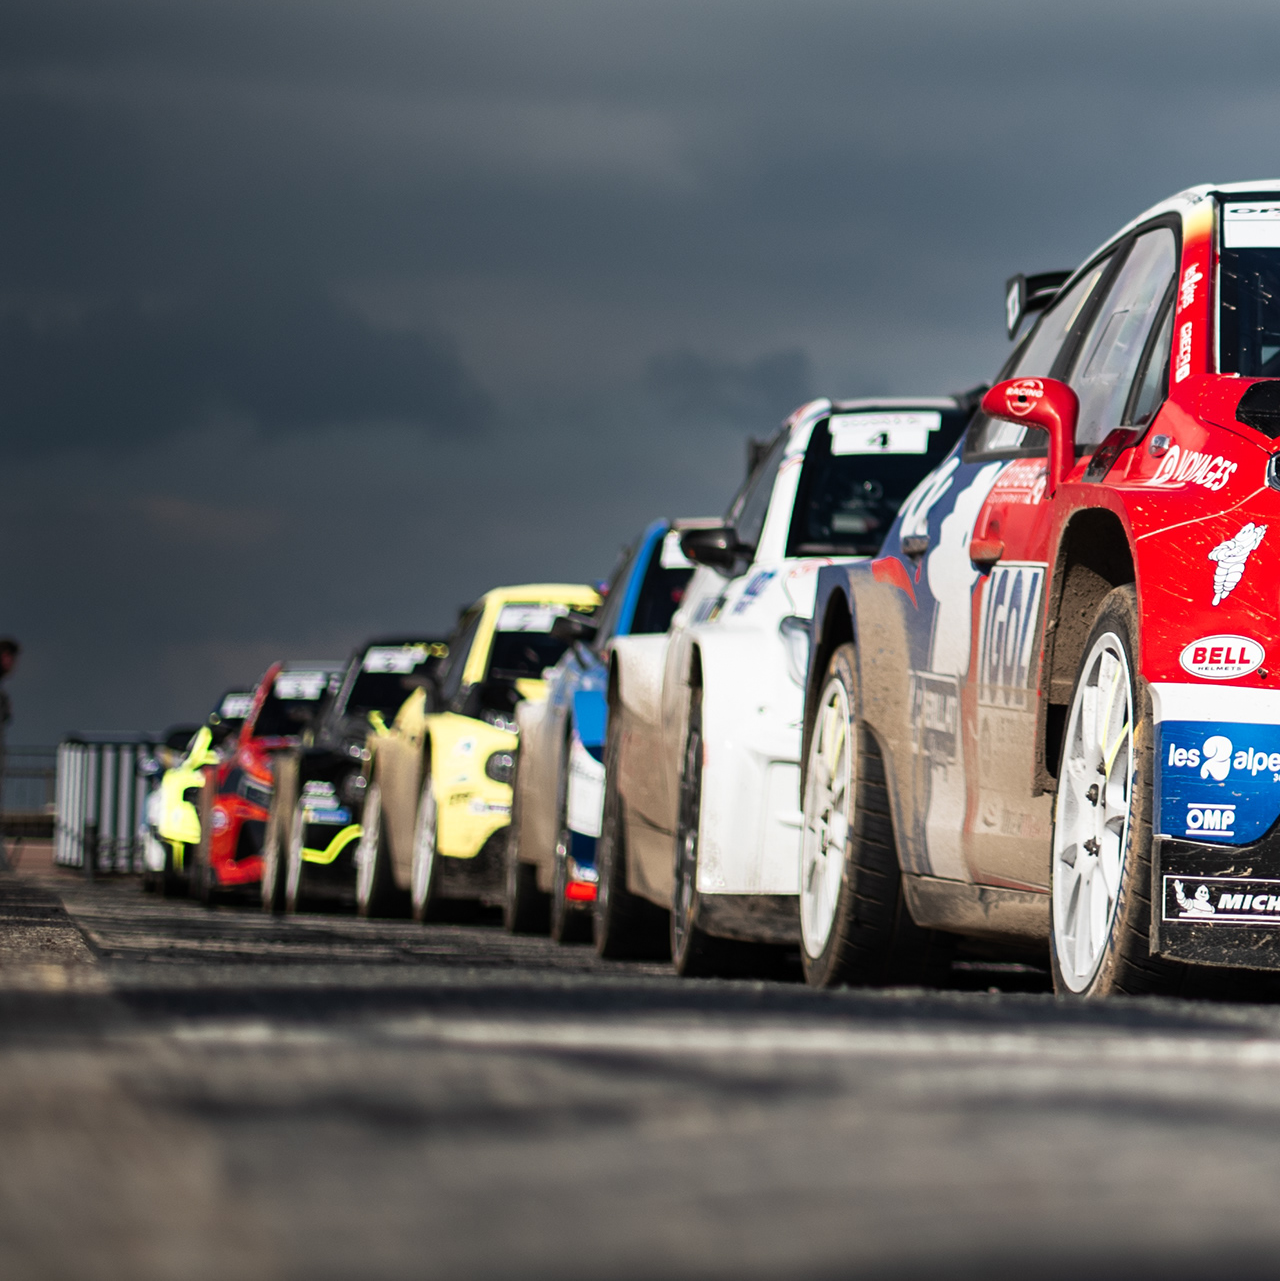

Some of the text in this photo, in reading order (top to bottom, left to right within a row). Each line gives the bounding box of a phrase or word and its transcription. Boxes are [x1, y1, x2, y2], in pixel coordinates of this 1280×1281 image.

[1006, 387, 1043, 398] RACING
[1173, 449, 1238, 491] VOYAGES
[1192, 647, 1251, 665] BELL
[1168, 743, 1200, 767] les
[1200, 735, 1234, 781] 2
[1186, 809, 1236, 830] OMP
